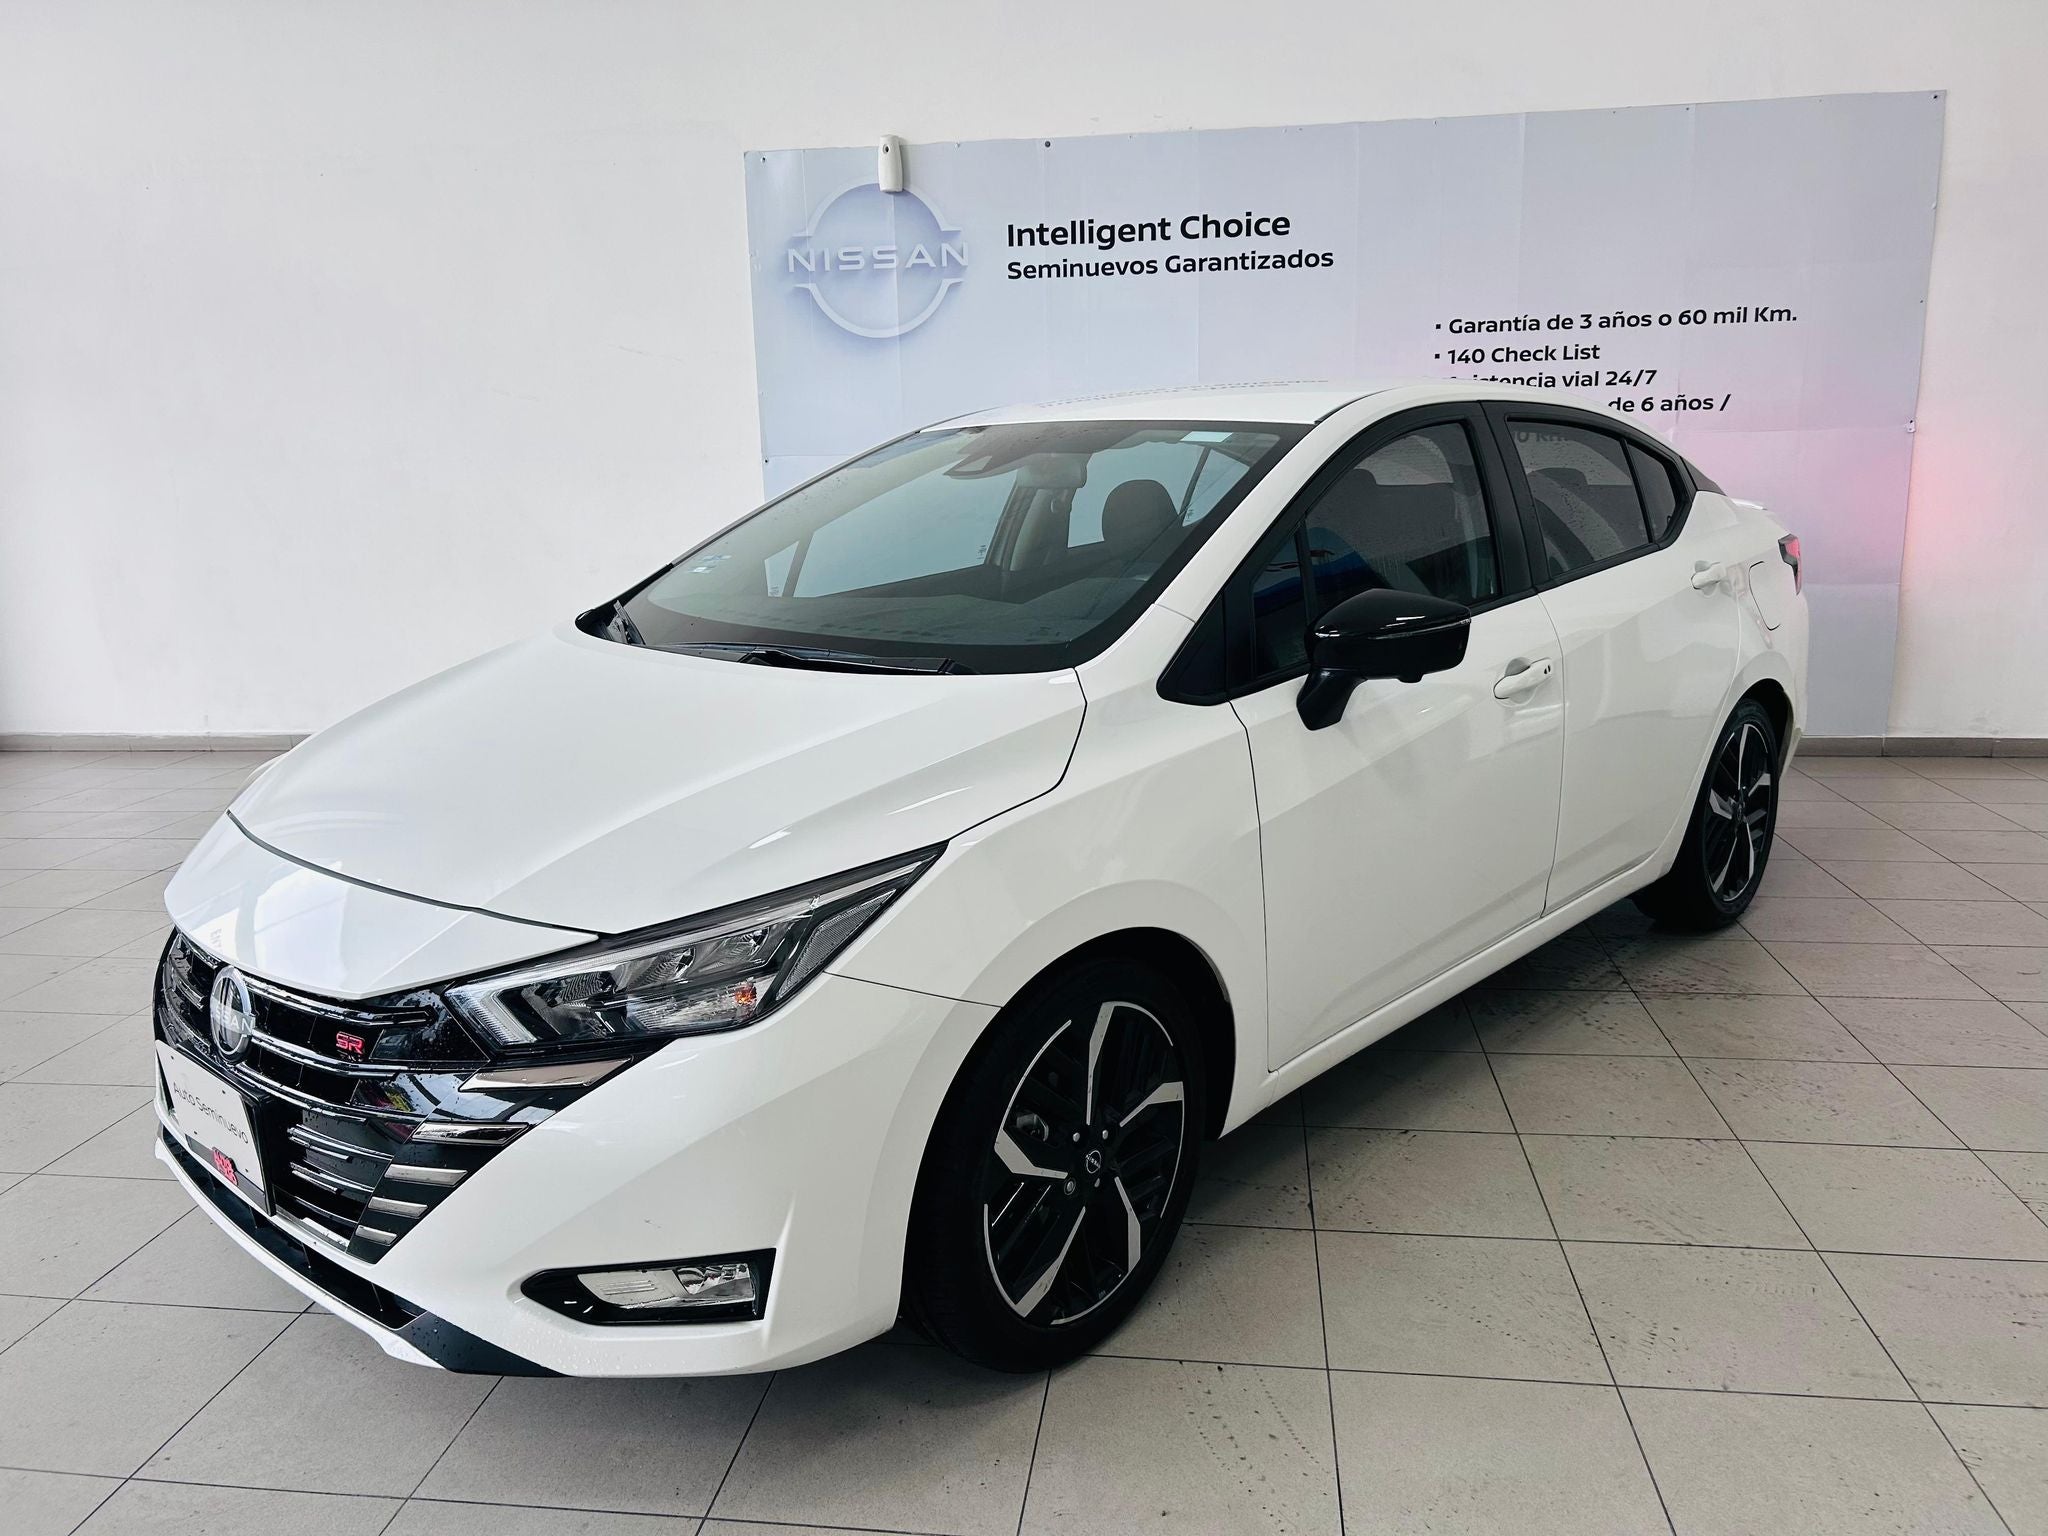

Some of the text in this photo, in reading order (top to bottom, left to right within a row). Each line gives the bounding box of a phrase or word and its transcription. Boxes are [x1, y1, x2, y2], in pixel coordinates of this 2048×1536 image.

[1007, 211, 1291, 251] Intelligent Choice
[787, 242, 968, 273] NISSAN
[1007, 248, 1334, 280] Seminuevos Garantizados
[1448, 306, 1797, 334] Garantía de 3 años o 60 mil Km.
[1447, 344, 1601, 365] 140 Check List
[1561, 370, 1600, 388] vial
[1605, 369, 1658, 387] 24/7
[1640, 396, 1655, 412] 6
[1660, 394, 1714, 412] años
[335, 1032, 364, 1055] SR
[172, 1082, 249, 1145] Auto Seminuevo
